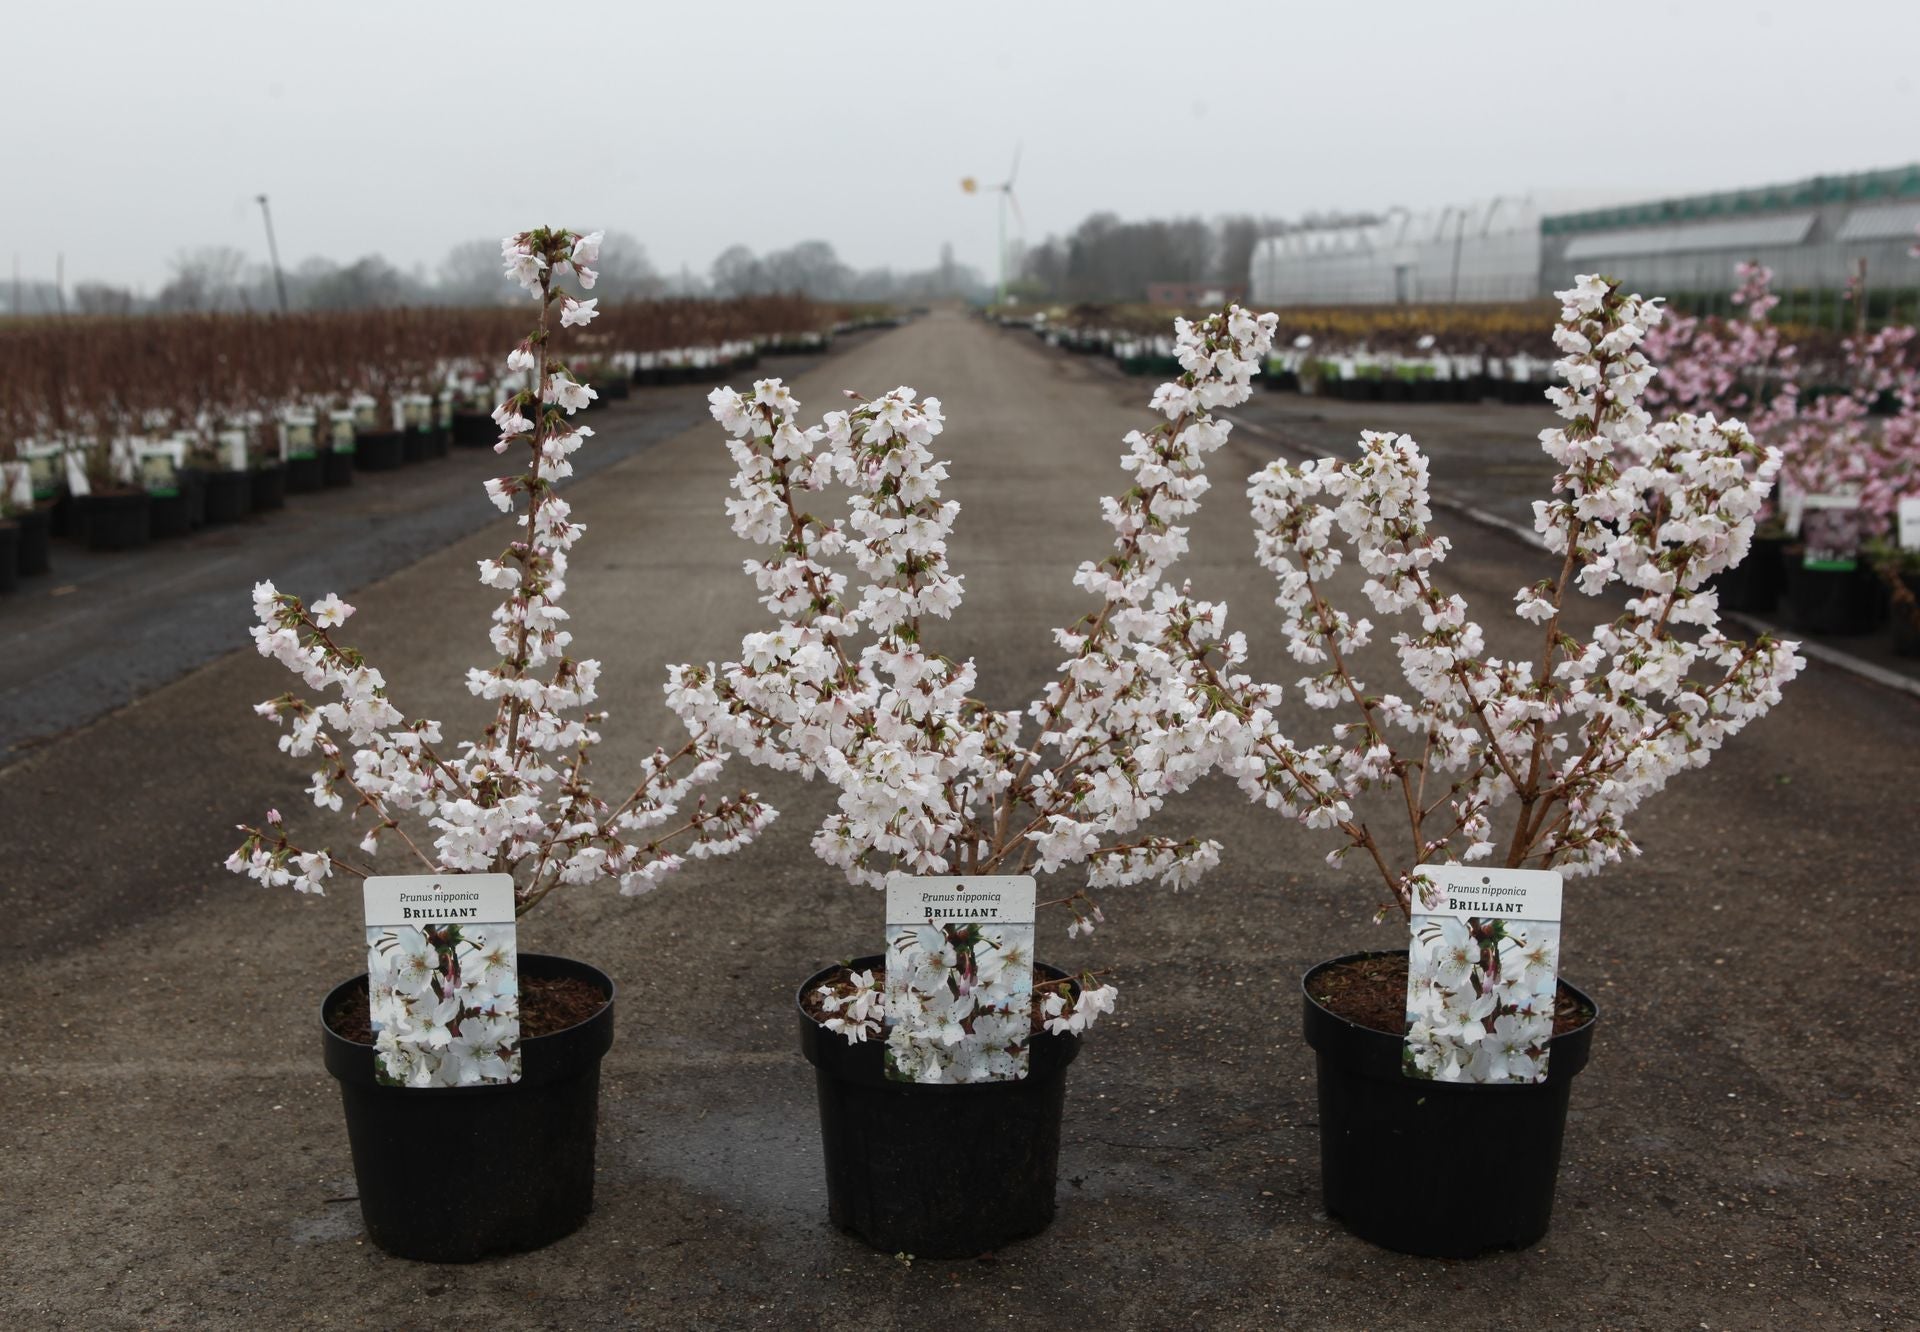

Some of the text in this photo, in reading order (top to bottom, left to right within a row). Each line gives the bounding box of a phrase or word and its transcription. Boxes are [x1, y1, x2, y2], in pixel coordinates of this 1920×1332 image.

[1447, 883, 1526, 897] Prunus nipponica
[400, 891, 479, 903] Prunus nipponica
[922, 892, 1001, 903] Prunus nipponica
[1449, 898, 1523, 913] BRILLIANT
[403, 907, 478, 919] BRILLIANT
[924, 907, 998, 917] BRILLIANT
